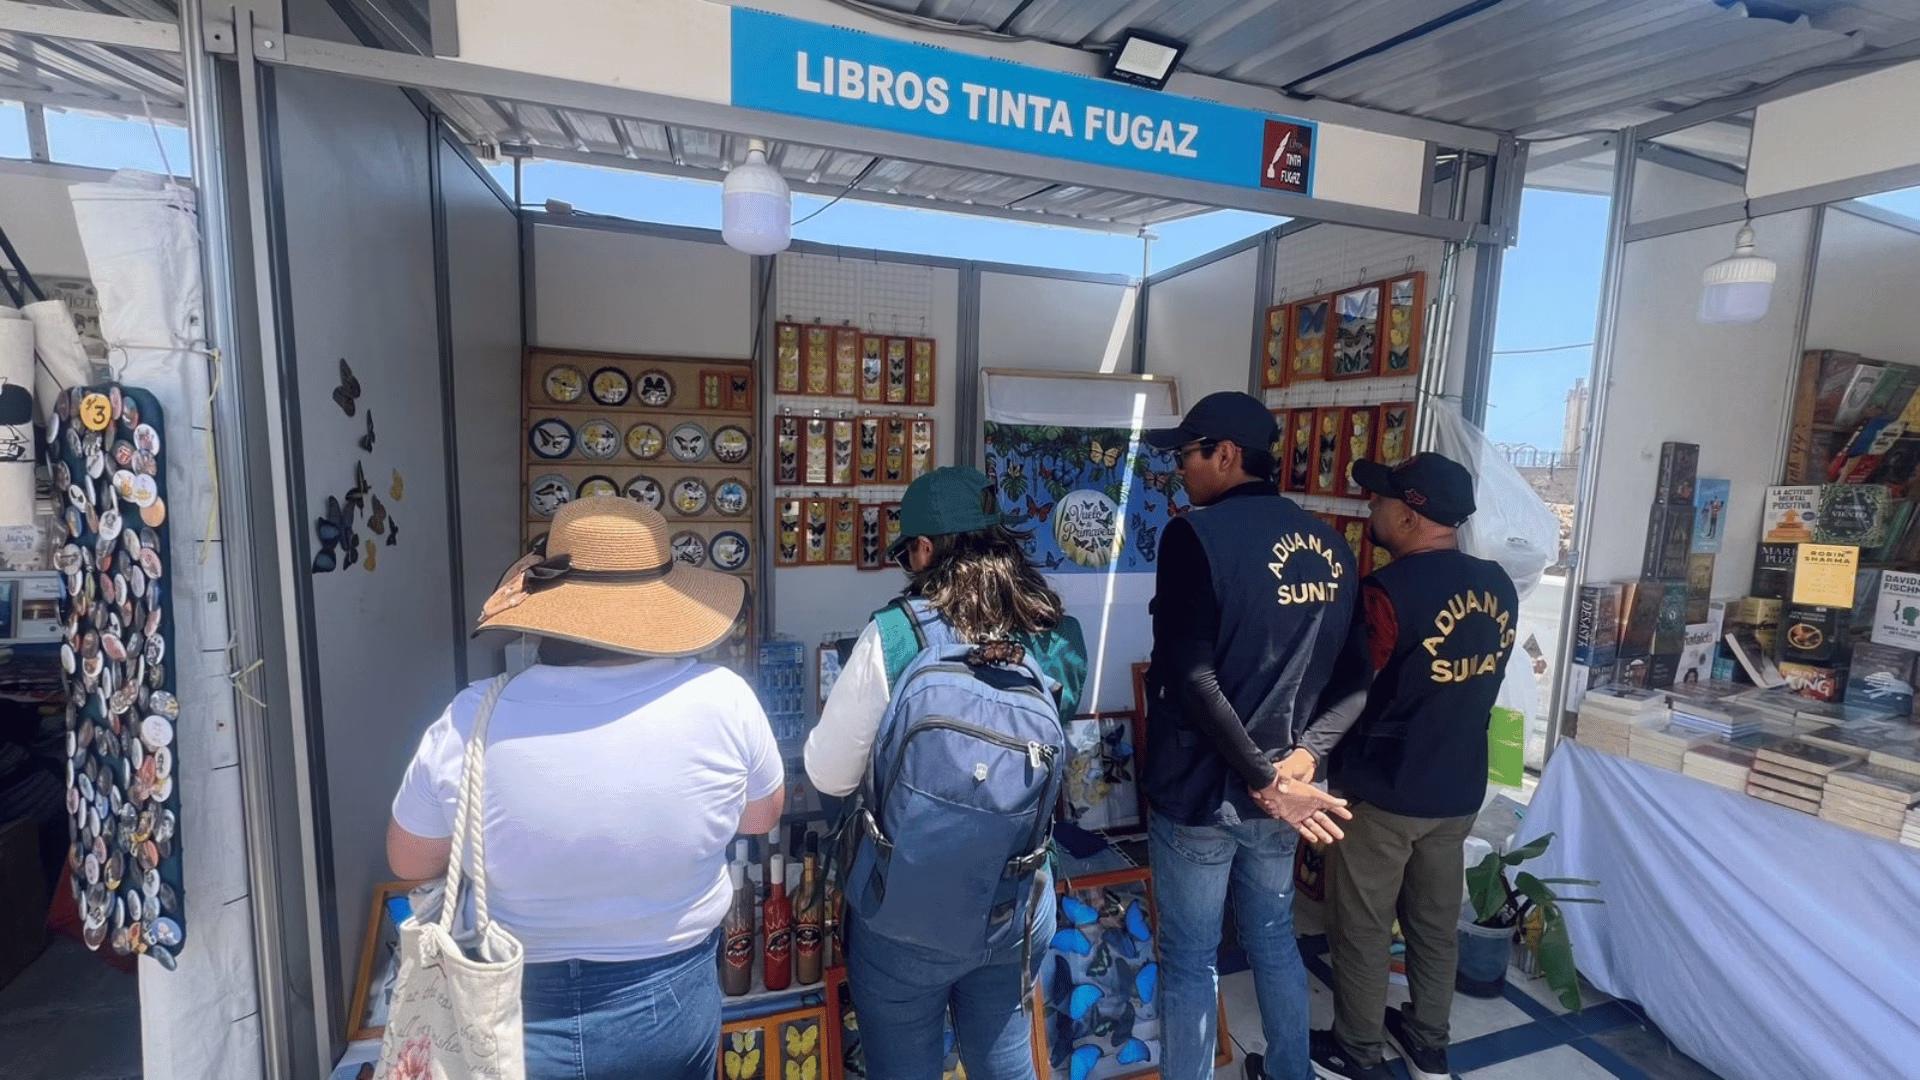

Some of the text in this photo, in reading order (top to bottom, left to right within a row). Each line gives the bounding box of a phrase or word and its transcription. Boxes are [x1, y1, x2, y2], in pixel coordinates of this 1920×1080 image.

[797, 50, 1199, 158] LIBROS TINTA FUGAZ
[1286, 153, 1302, 168] TINTA
[1281, 169, 1301, 185] FUGAZ
[93, 405, 106, 425] 3
[1069, 504, 1102, 522] Vuelo
[1062, 522, 1116, 542] Primavera
[1268, 532, 1343, 580] ADUANAS
[1805, 556, 1851, 564] SHARMA
[1885, 575, 1920, 586] DAVID
[1277, 581, 1339, 605] SUNT
[1422, 590, 1516, 656] ADUANAS
